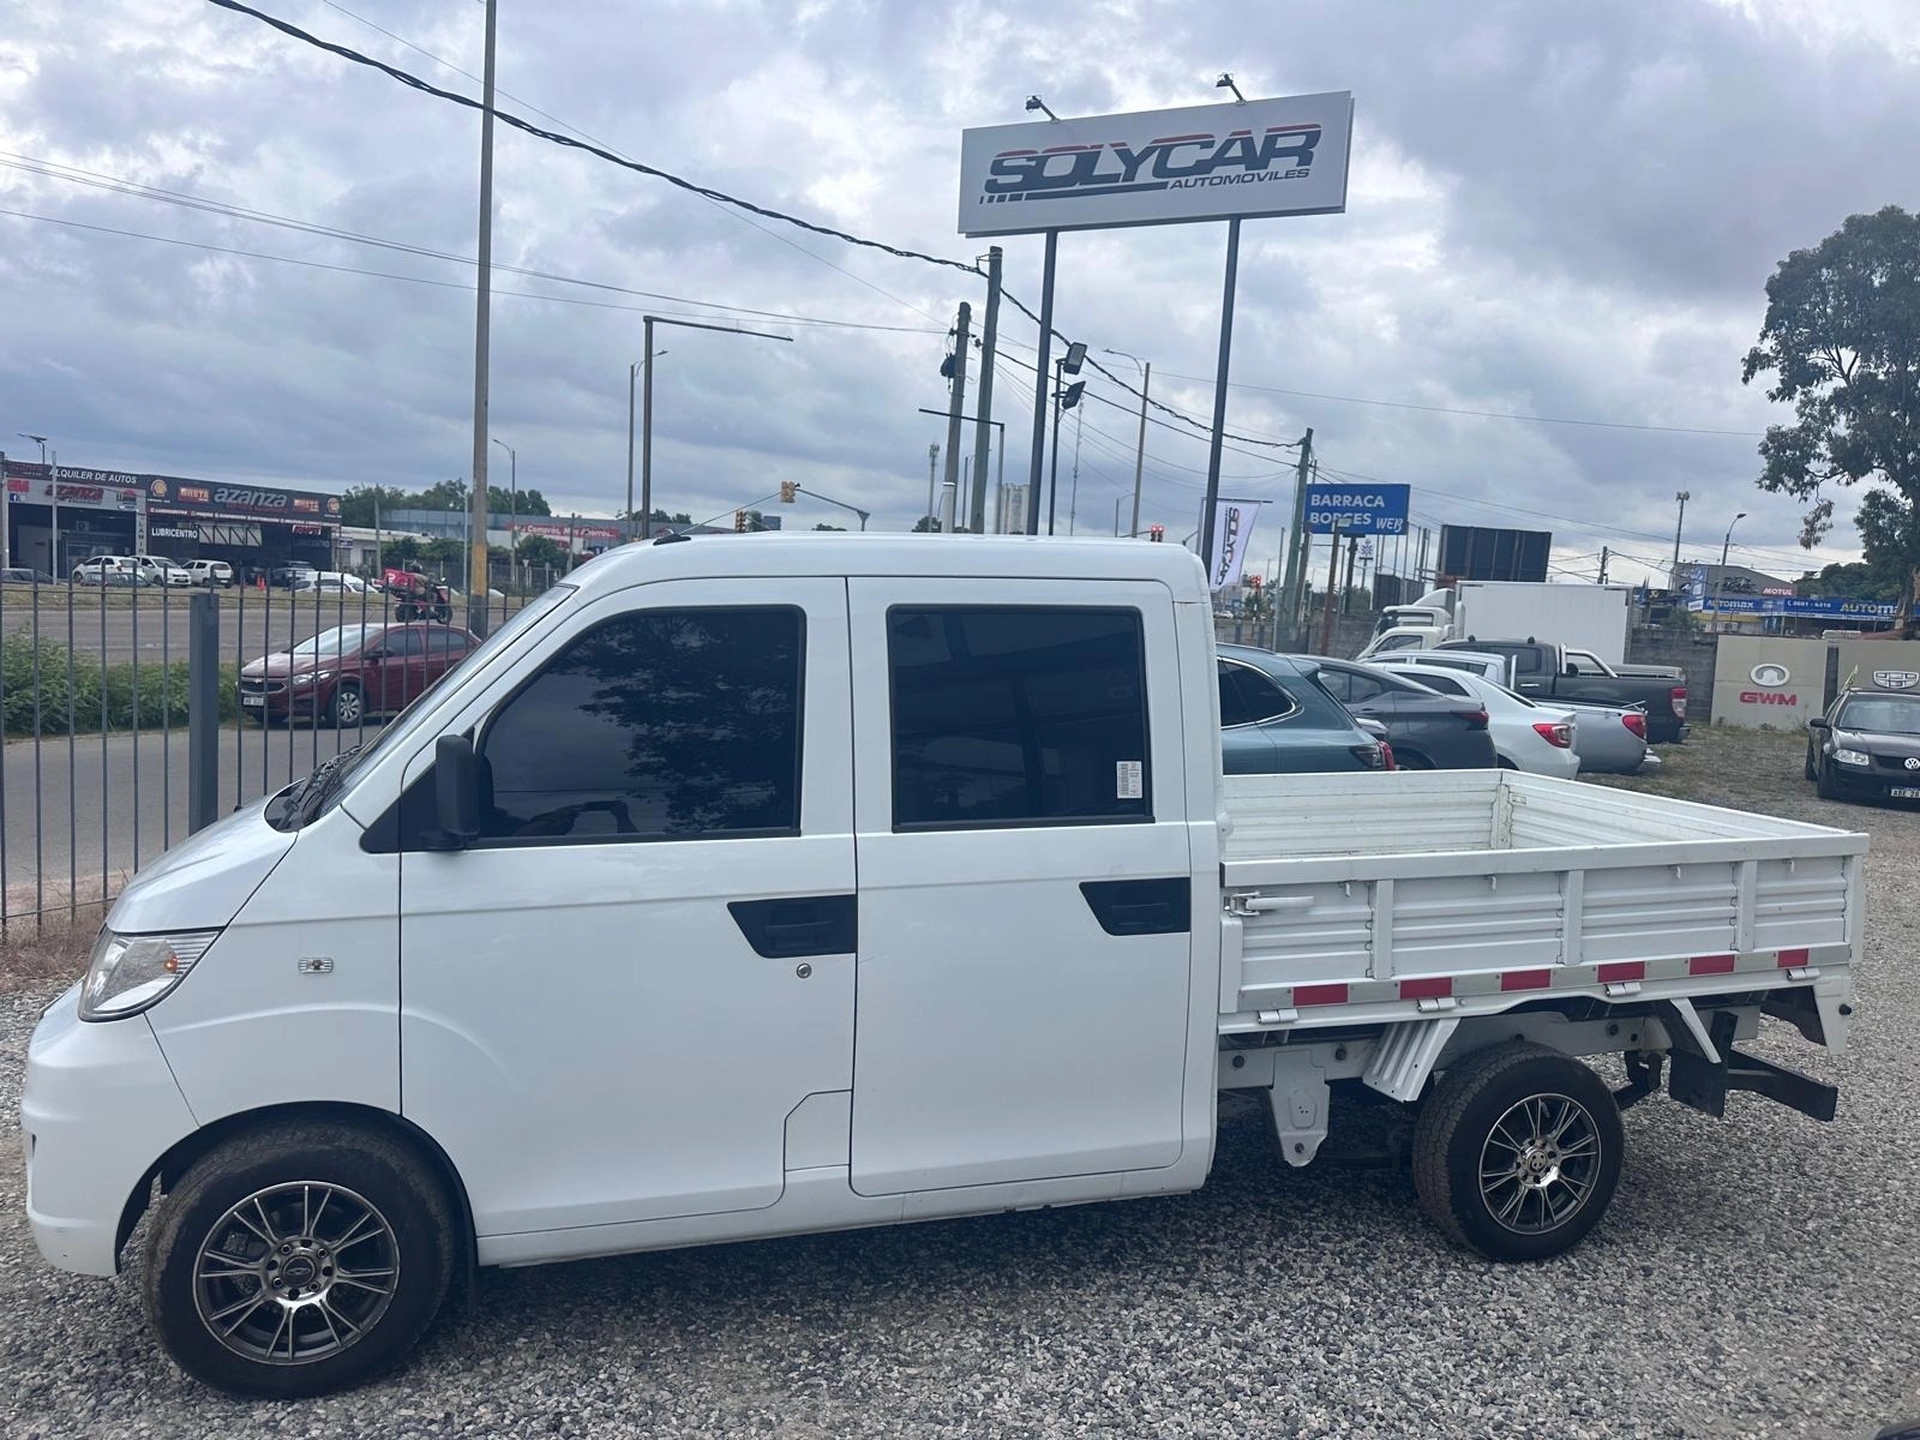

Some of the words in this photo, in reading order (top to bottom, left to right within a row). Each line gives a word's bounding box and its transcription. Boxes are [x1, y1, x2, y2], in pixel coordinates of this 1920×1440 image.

[984, 123, 1322, 195] SOLYCAR
[1168, 167, 1311, 190] AUTOMOVILES
[94, 472, 107, 481] DE
[108, 474, 137, 484] AUTOS
[214, 487, 287, 508] azanza
[1310, 494, 1385, 507] BARRACA
[151, 527, 198, 539] LUBRICENTRO
[1763, 587, 1793, 596] MOTUL
[1740, 691, 1797, 706] GWM
